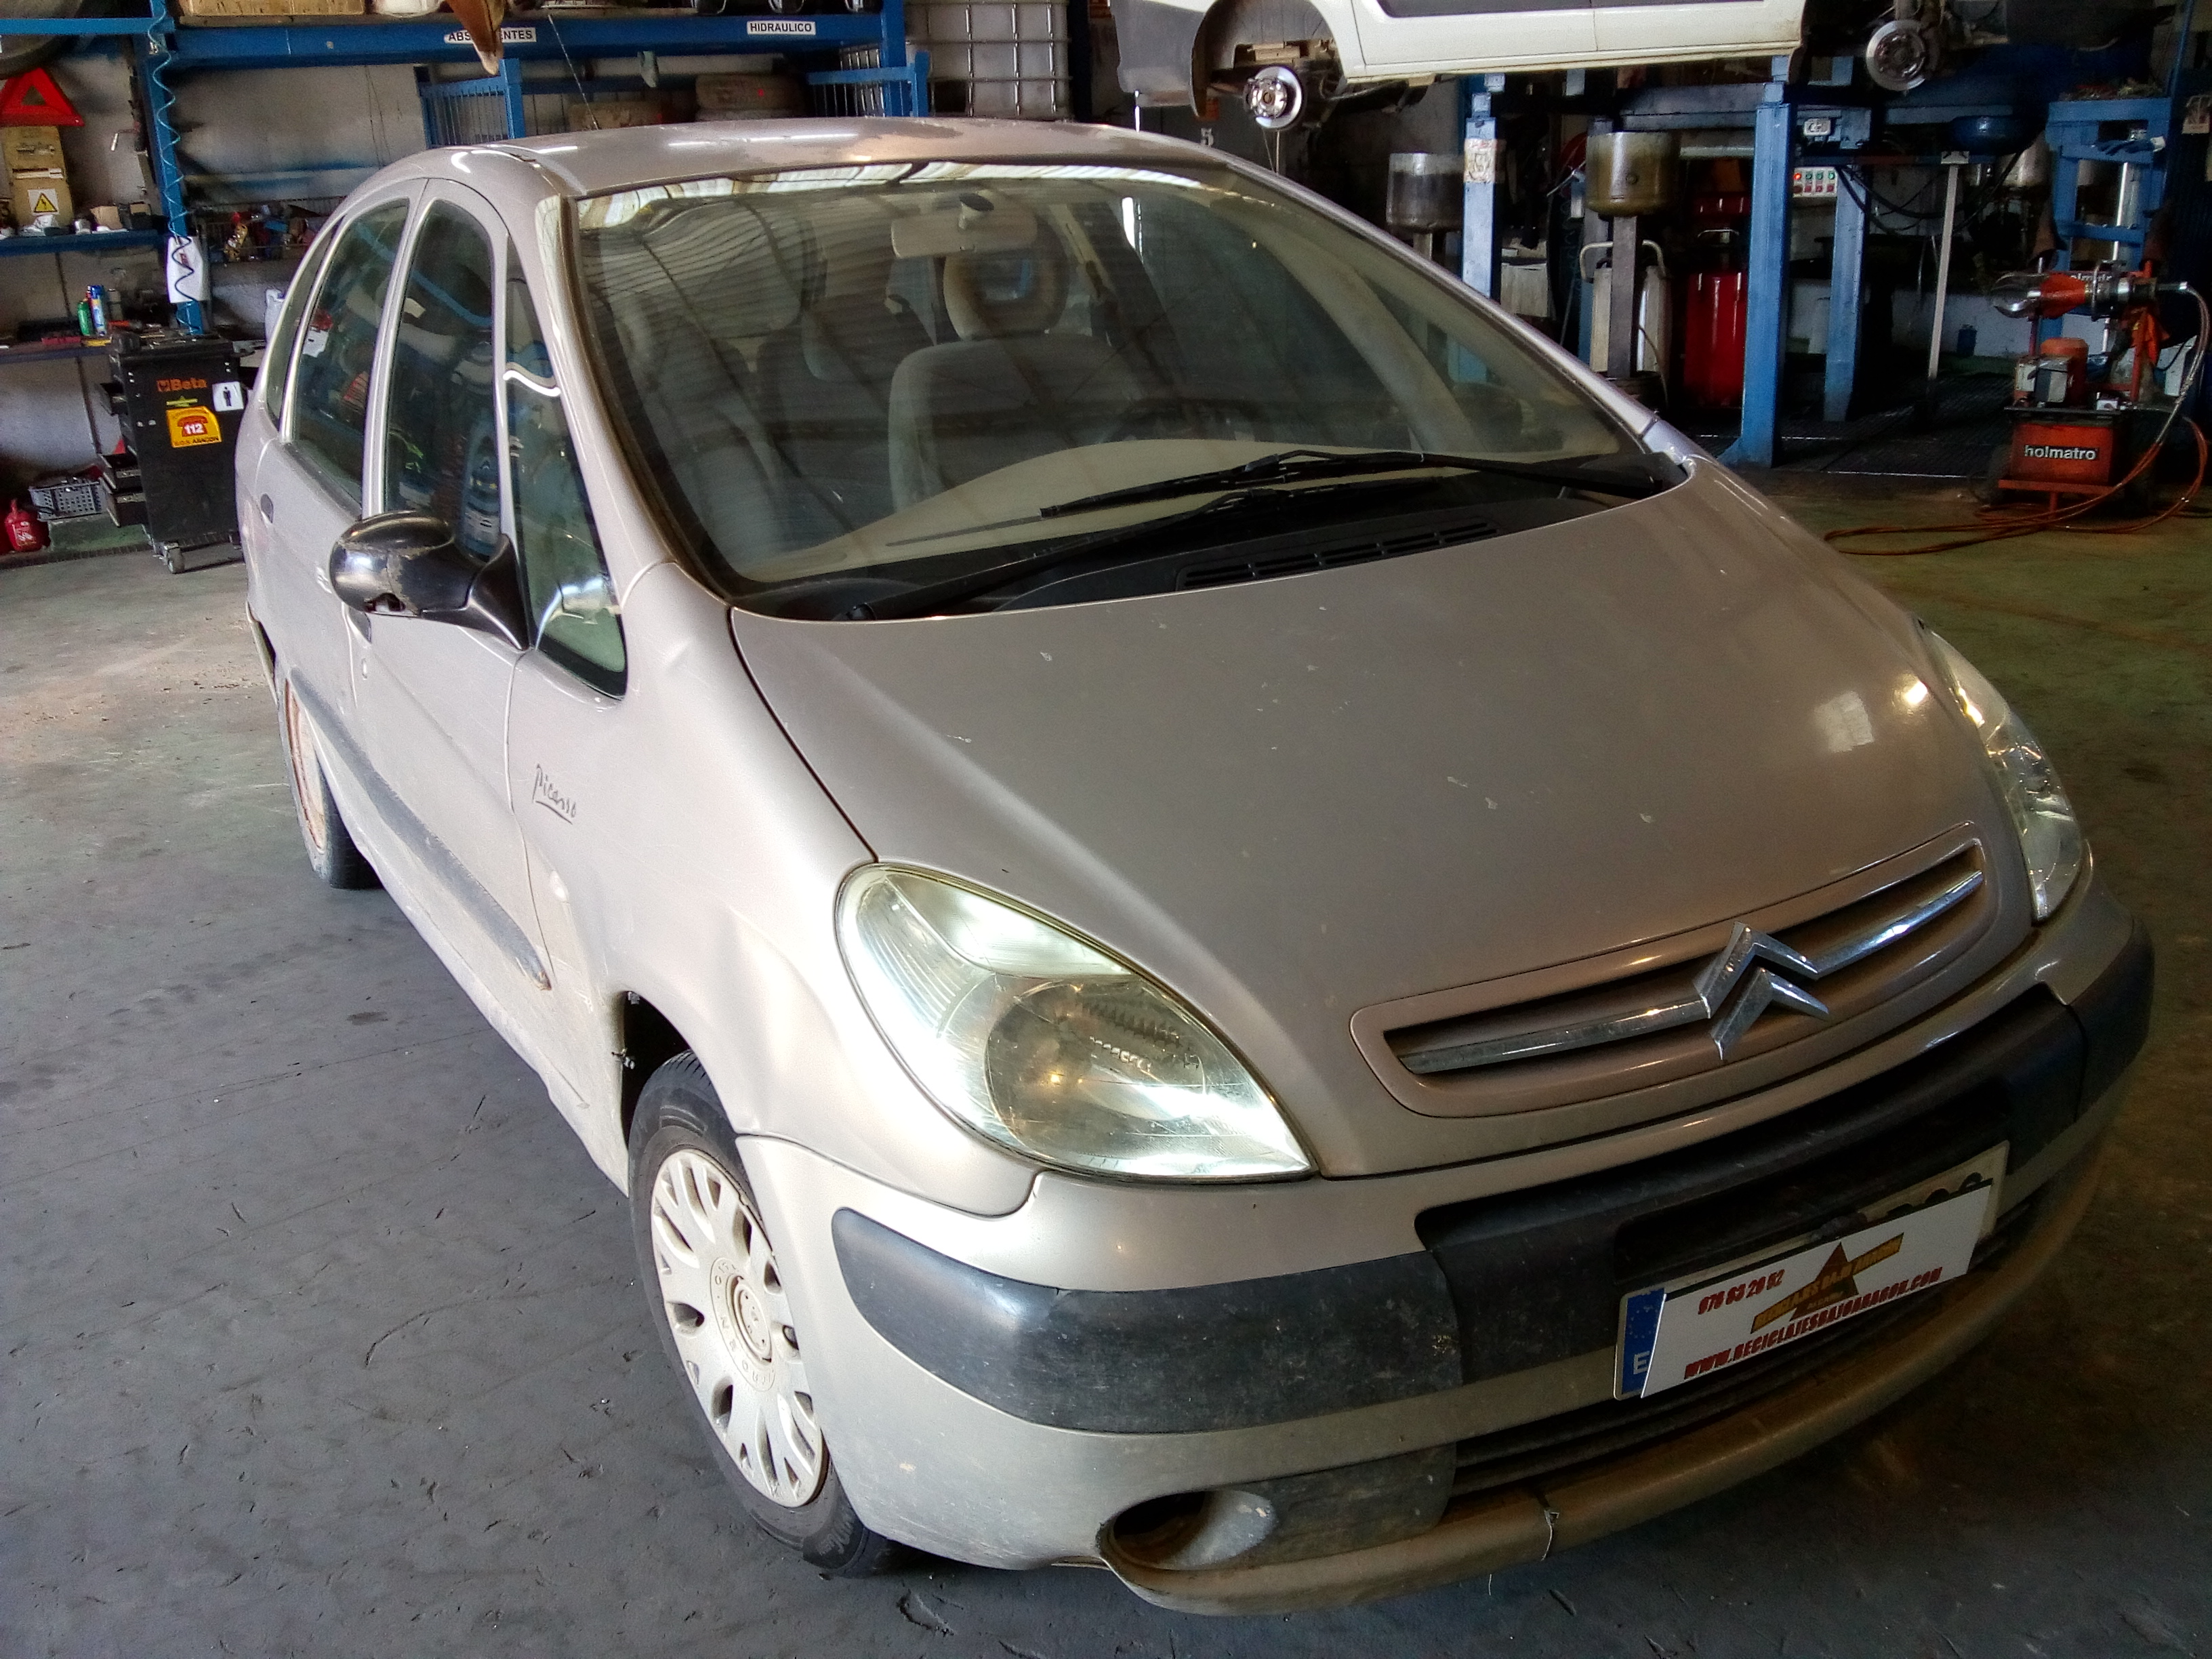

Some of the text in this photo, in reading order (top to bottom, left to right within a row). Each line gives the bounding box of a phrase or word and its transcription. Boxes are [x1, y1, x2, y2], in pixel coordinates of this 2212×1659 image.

[750, 22, 812, 33] HIDRAULICO
[184, 422, 205, 434] 112
[2024, 445, 2097, 460] holmatro
[1633, 1351, 1651, 1374] E
